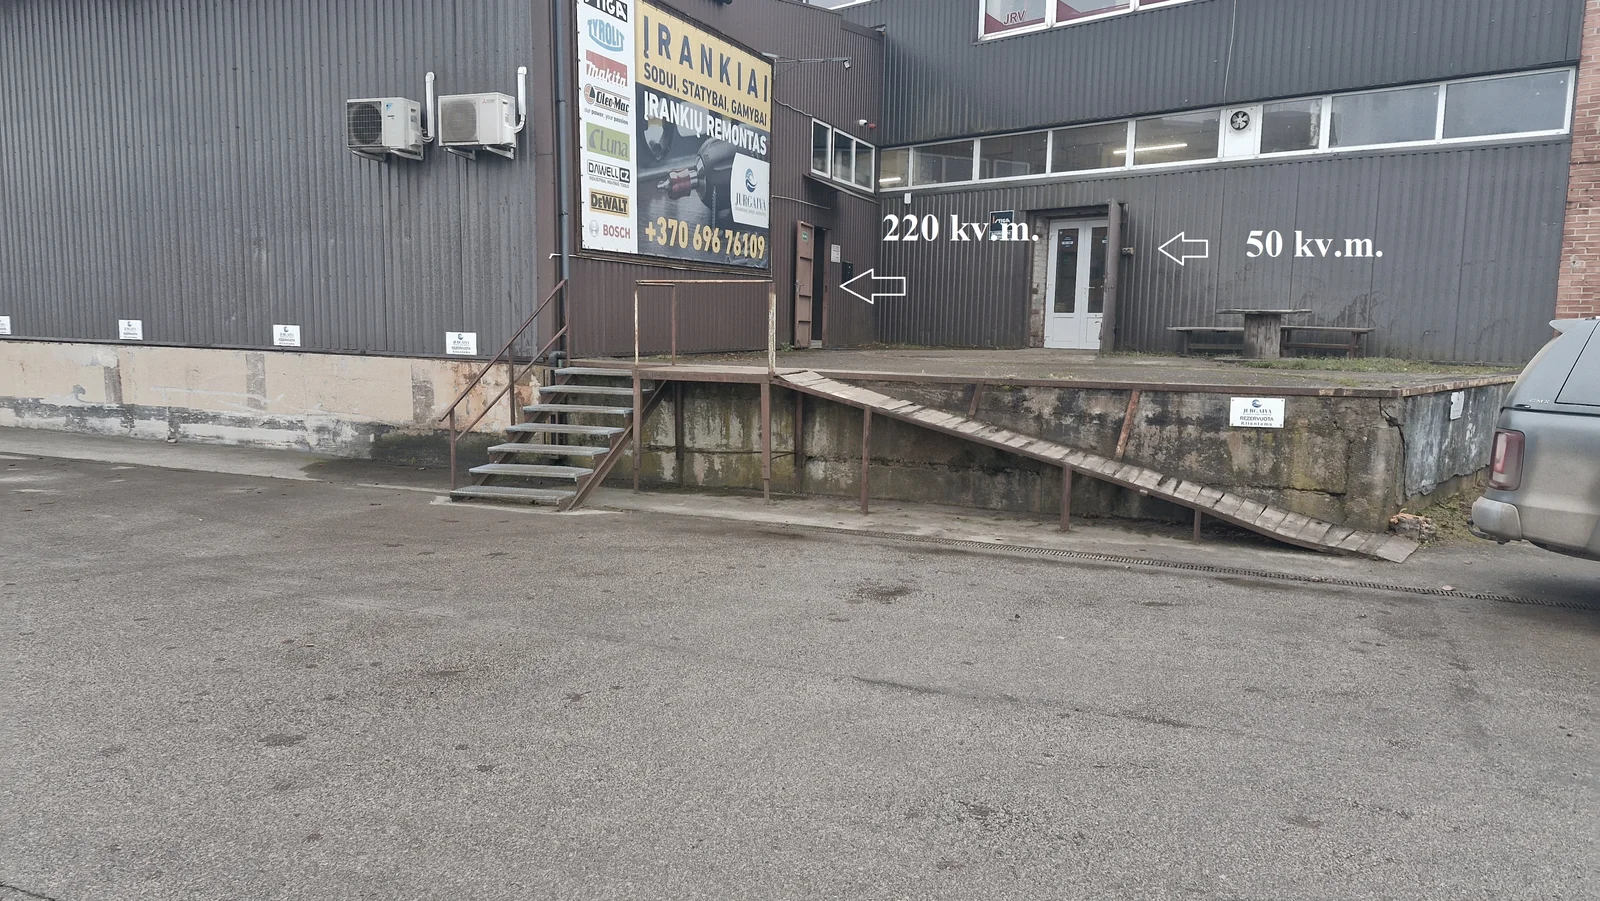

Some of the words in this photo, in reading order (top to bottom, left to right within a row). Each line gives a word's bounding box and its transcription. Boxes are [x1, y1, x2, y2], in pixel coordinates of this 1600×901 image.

[1003, 10, 1025, 25] JRV
[587, 19, 625, 47] TYROLIT
[643, 15, 768, 103] ĮRANKIAI
[596, 91, 629, 113] Oleo-Mac
[643, 62, 680, 93] SODUI,
[682, 78, 730, 113] STATYBAI,
[731, 99, 767, 127] GAMYBAI
[643, 91, 703, 138] ĮRANKIŲ
[706, 115, 767, 155] REMONTAS
[588, 162, 619, 179] DAWELL
[602, 223, 631, 240] BOSCH
[645, 216, 689, 249] +370
[692, 223, 721, 254] 696
[725, 229, 765, 259] 76109
